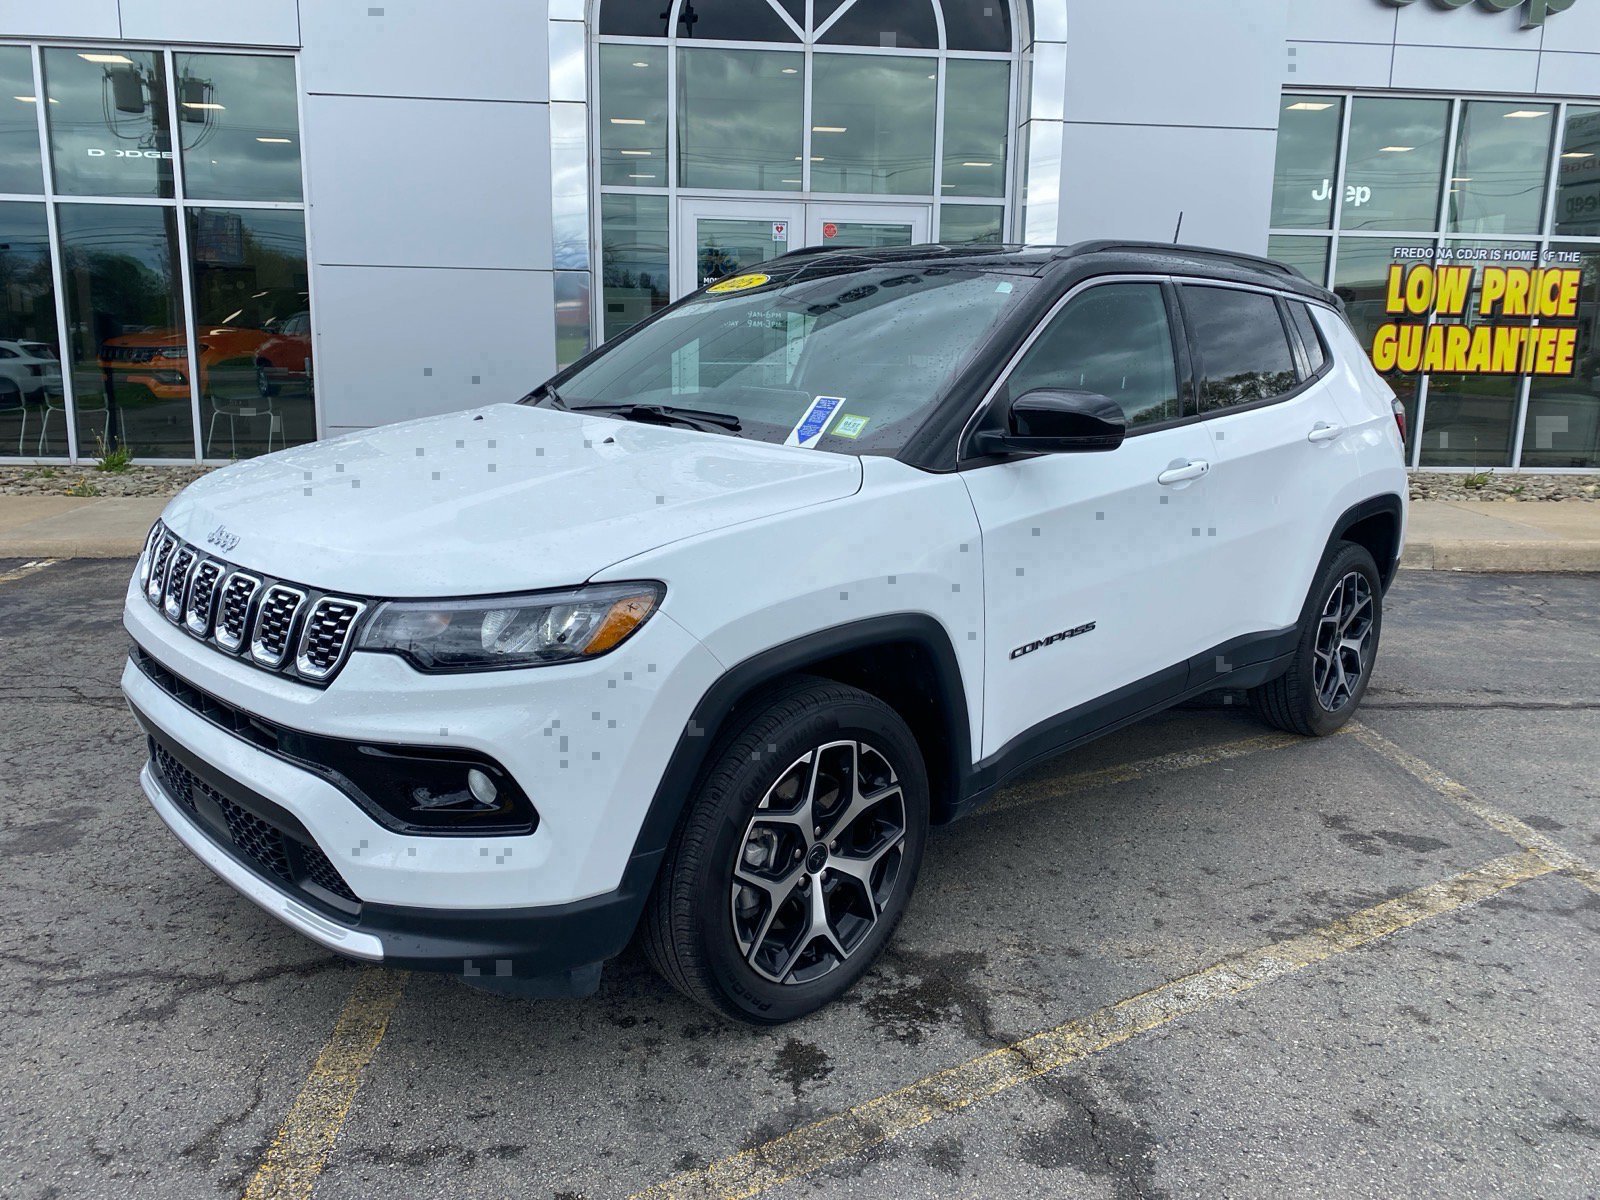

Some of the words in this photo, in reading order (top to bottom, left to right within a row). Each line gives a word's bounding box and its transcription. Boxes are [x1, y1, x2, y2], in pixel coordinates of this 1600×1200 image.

[1312, 178, 1371, 207] Jep
[1456, 249, 1487, 261] CDJR
[1489, 250, 1501, 260] IS
[1503, 250, 1538, 261] HOME
[1557, 251, 1581, 262] THE
[1386, 264, 1473, 315] LOW
[1479, 266, 1581, 317] PRICE
[1372, 323, 1578, 374] GUARANTEE
[207, 524, 241, 553] Jeep
[1009, 621, 1096, 660] COMPASS
